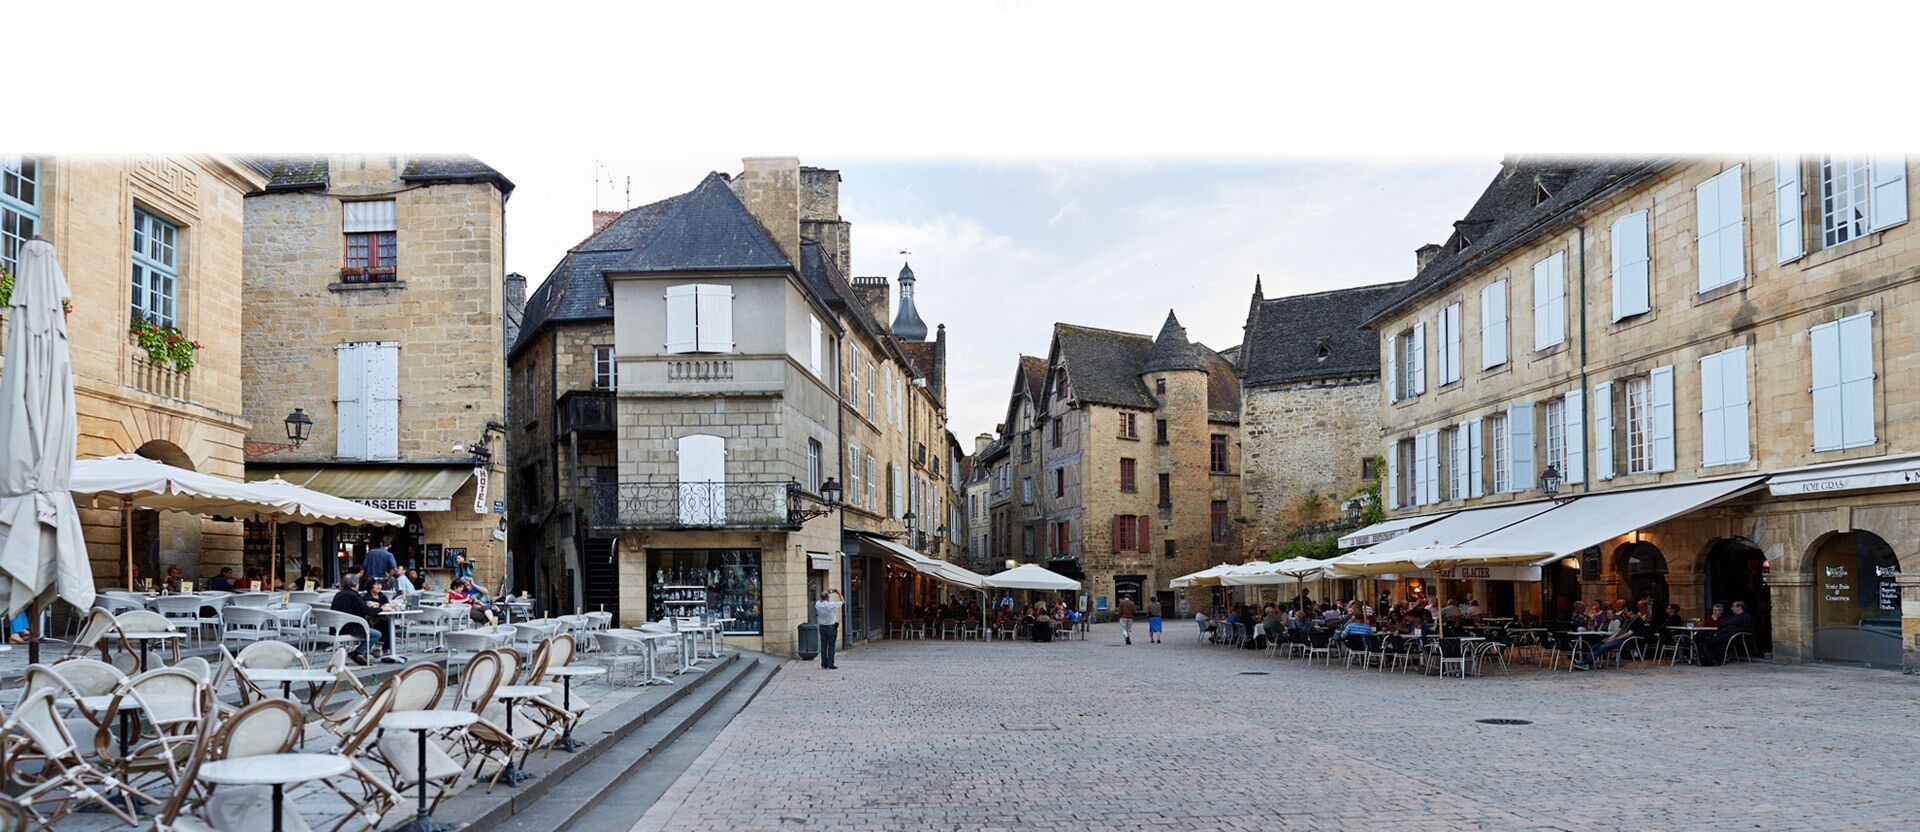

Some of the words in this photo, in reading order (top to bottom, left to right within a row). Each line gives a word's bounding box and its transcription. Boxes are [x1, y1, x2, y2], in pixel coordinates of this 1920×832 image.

[477, 469, 486, 508] HOTEL
[1803, 482, 1820, 492] FOIE
[1821, 480, 1845, 491] GRAS
[350, 500, 417, 510] ASSERIE
[1462, 567, 1490, 578] GLACIER
